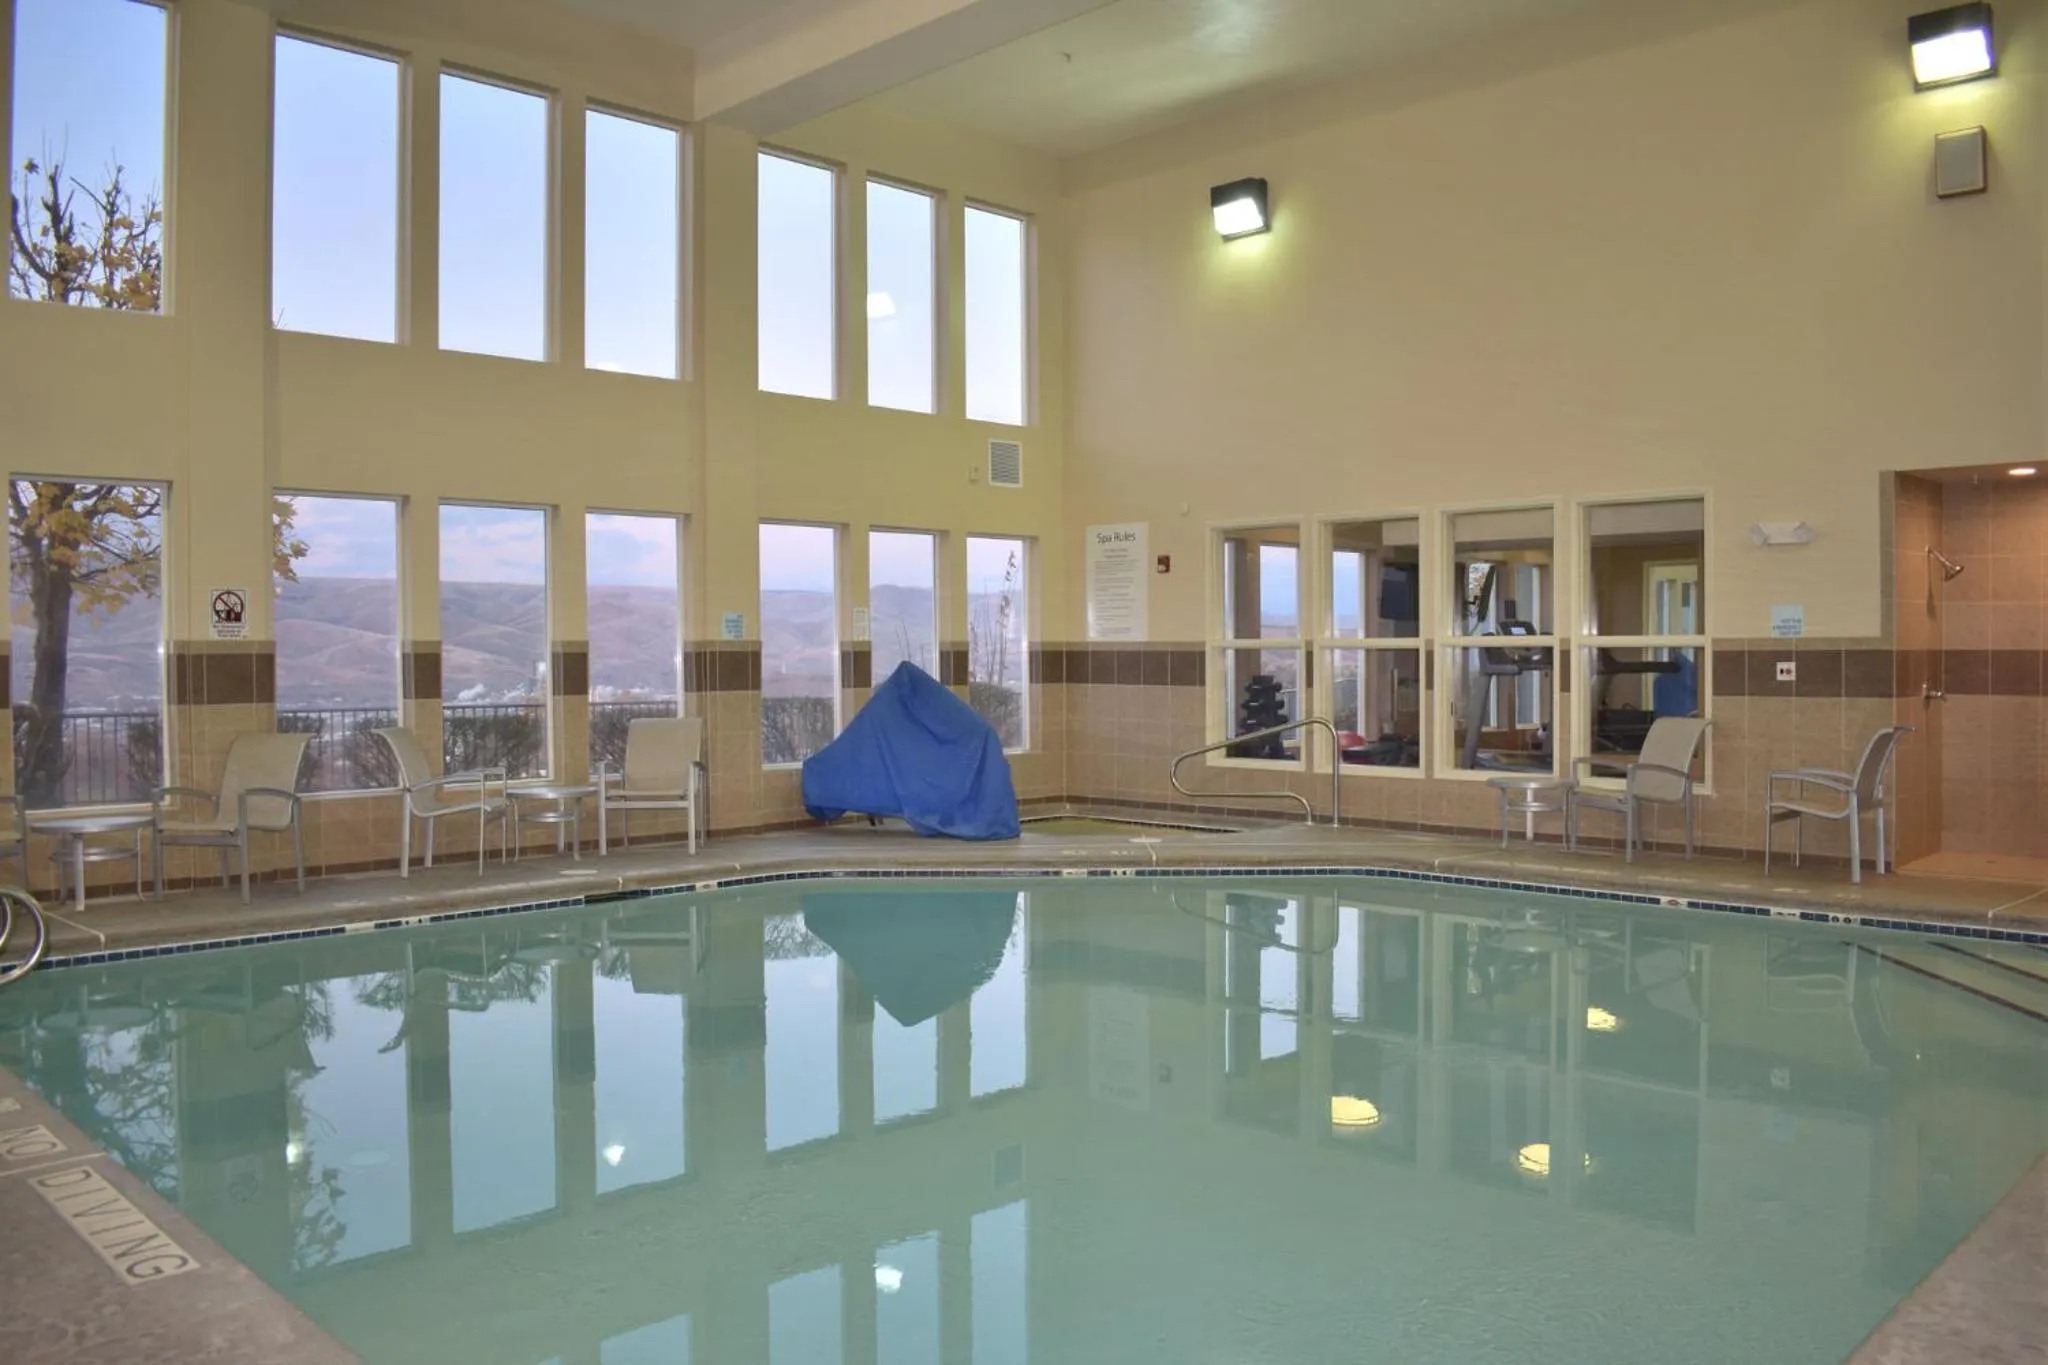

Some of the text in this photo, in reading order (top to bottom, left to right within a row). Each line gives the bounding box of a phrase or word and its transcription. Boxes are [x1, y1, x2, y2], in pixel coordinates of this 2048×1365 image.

[1096, 531, 1136, 544] Spa Rules
[0, 1126, 189, 1279] NO DIVING
